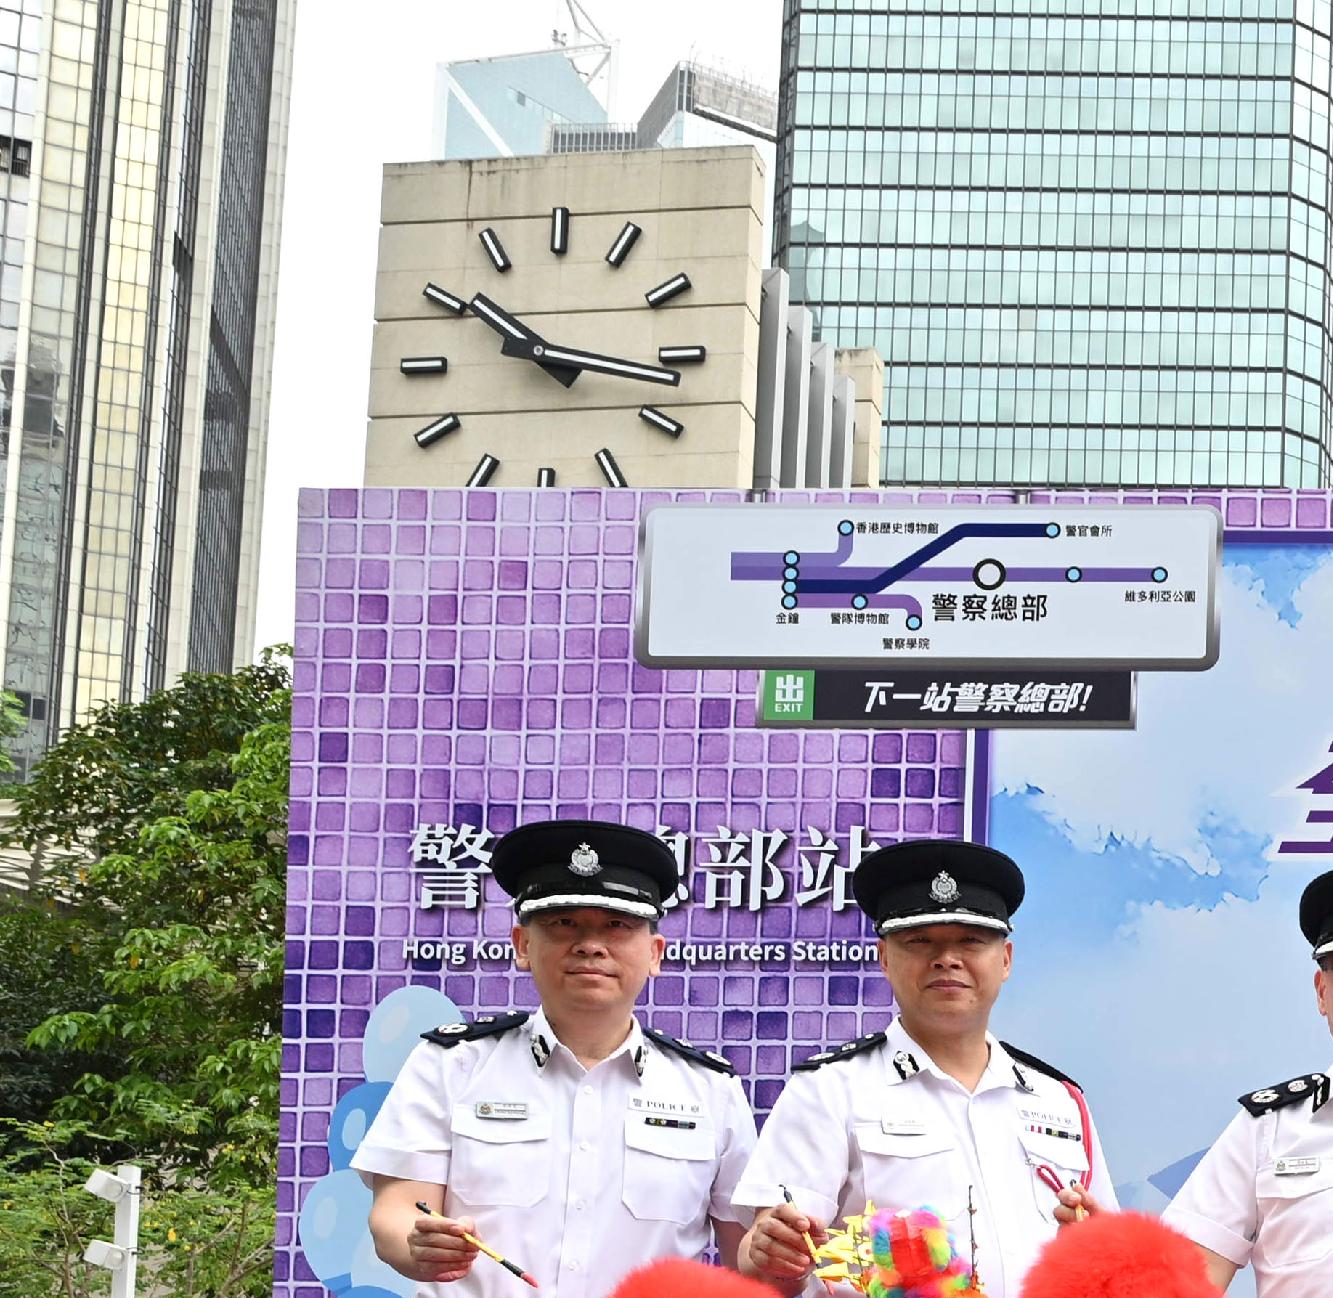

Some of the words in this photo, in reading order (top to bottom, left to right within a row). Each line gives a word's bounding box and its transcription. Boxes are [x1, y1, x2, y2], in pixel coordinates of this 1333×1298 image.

[857, 521, 939, 535] 香港歷史博物館
[1065, 524, 1113, 538] 警官會所
[1124, 589, 1197, 603] 維多利亞公園
[931, 593, 1048, 623] 警察總部
[775, 612, 800, 625] 金鐘
[830, 612, 890, 626] 警隊博物館
[882, 637, 931, 650] 警察學院
[775, 674, 804, 702] 出
[774, 703, 804, 713] EXIT
[406, 822, 880, 912] 警部站
[401, 940, 467, 964] Hong
[472, 940, 516, 961] Kon
[791, 939, 878, 962] Station
